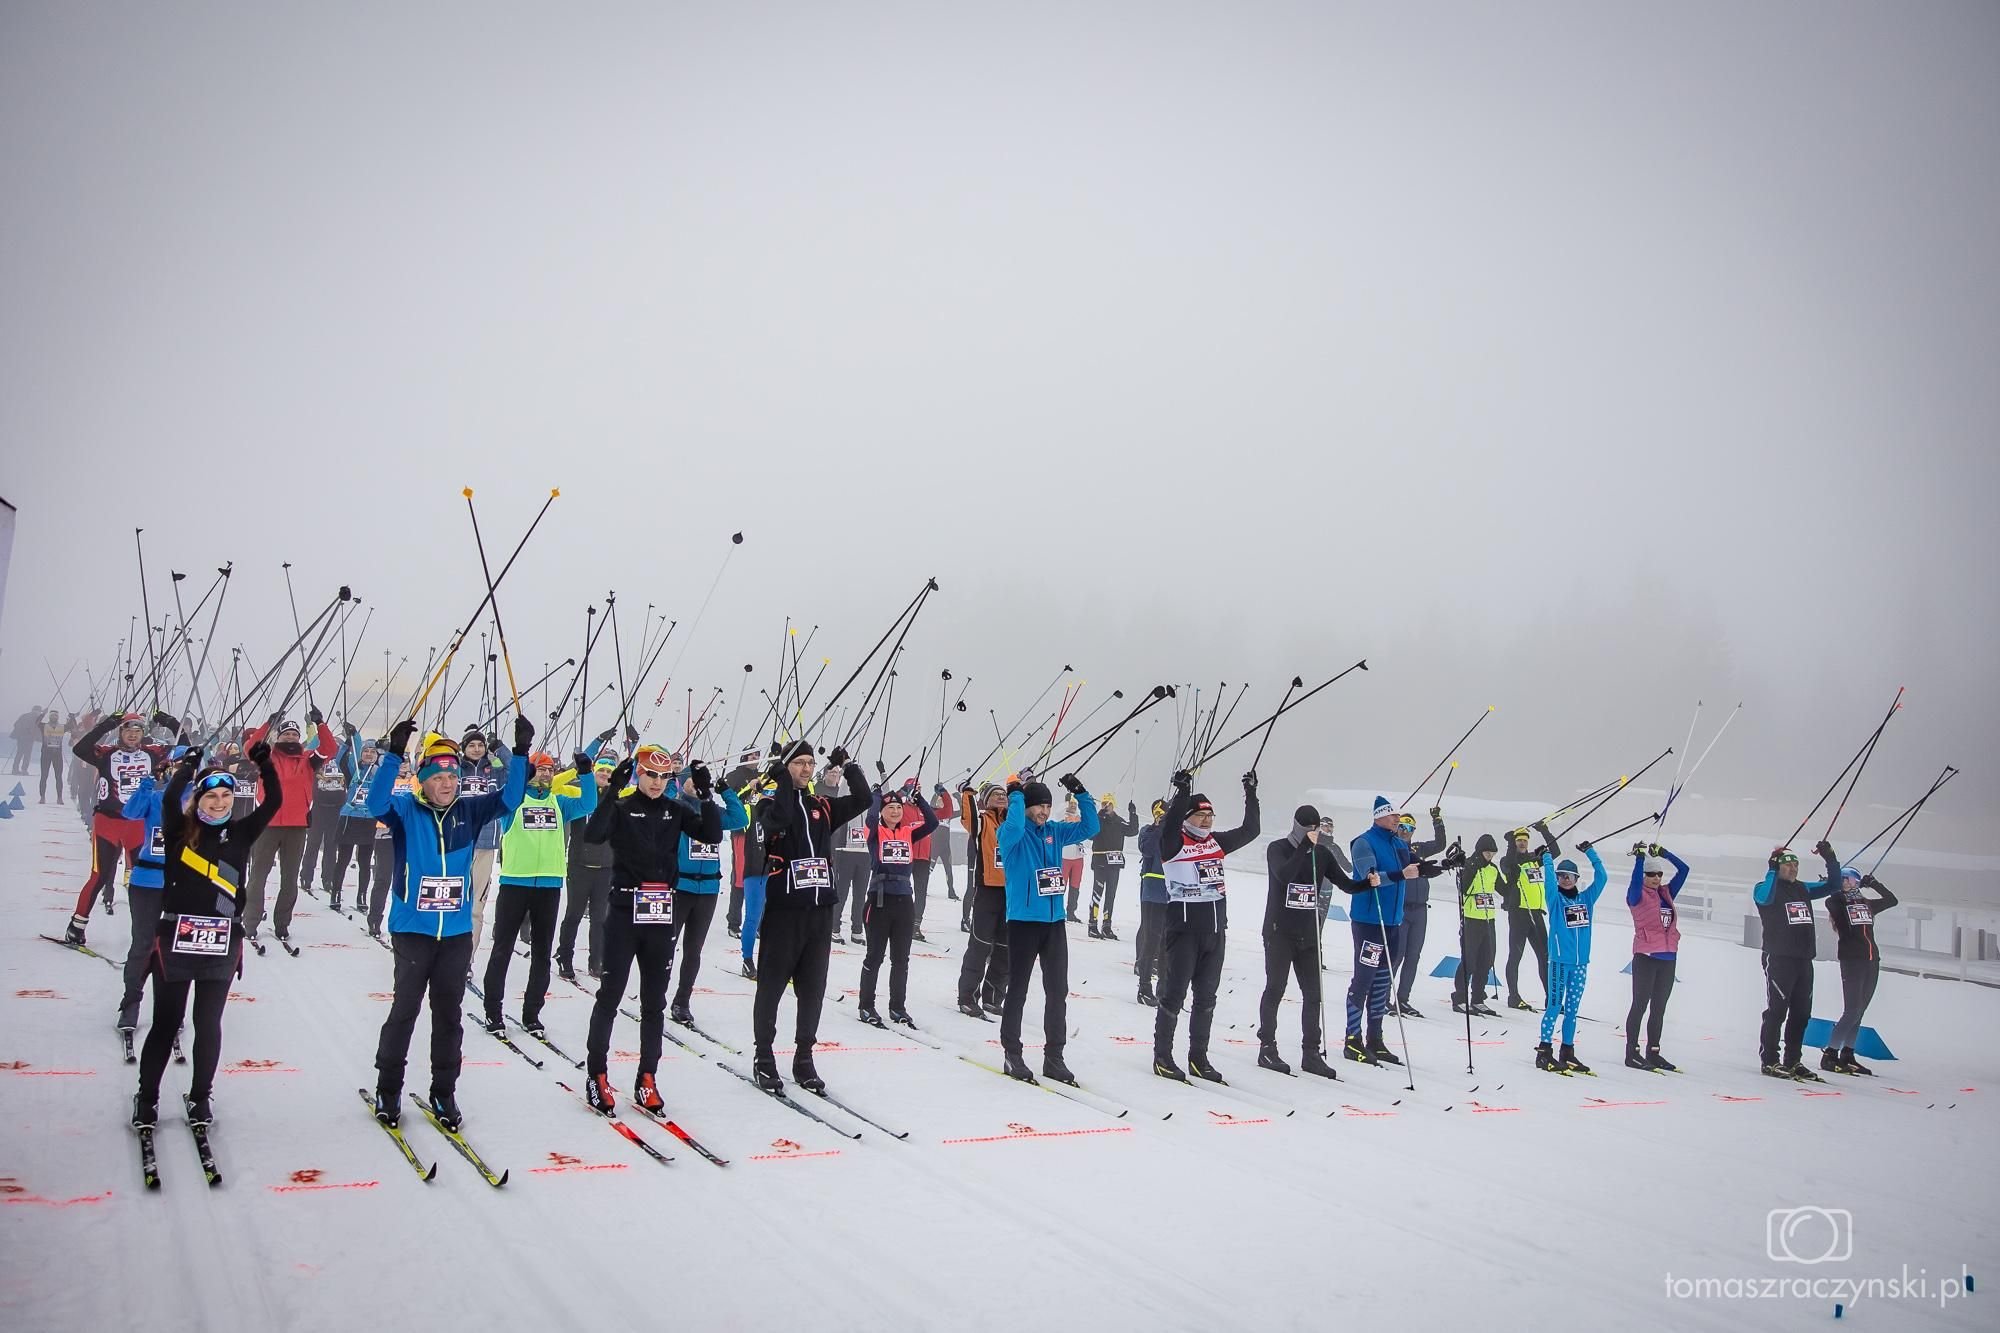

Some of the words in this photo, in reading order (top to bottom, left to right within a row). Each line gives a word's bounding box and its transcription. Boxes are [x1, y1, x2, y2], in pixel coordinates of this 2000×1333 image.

[470, 783, 480, 792] 62
[534, 815, 547, 824] 53
[700, 843, 712, 854] 24
[892, 848, 903, 858] 23
[807, 868, 820, 879] 44
[1204, 868, 1220, 878] 102
[1049, 876, 1061, 888] 39
[1297, 893, 1309, 903] 40
[649, 902, 664, 914] 69
[1575, 912, 1585, 922] 78
[190, 930, 217, 944] 128
